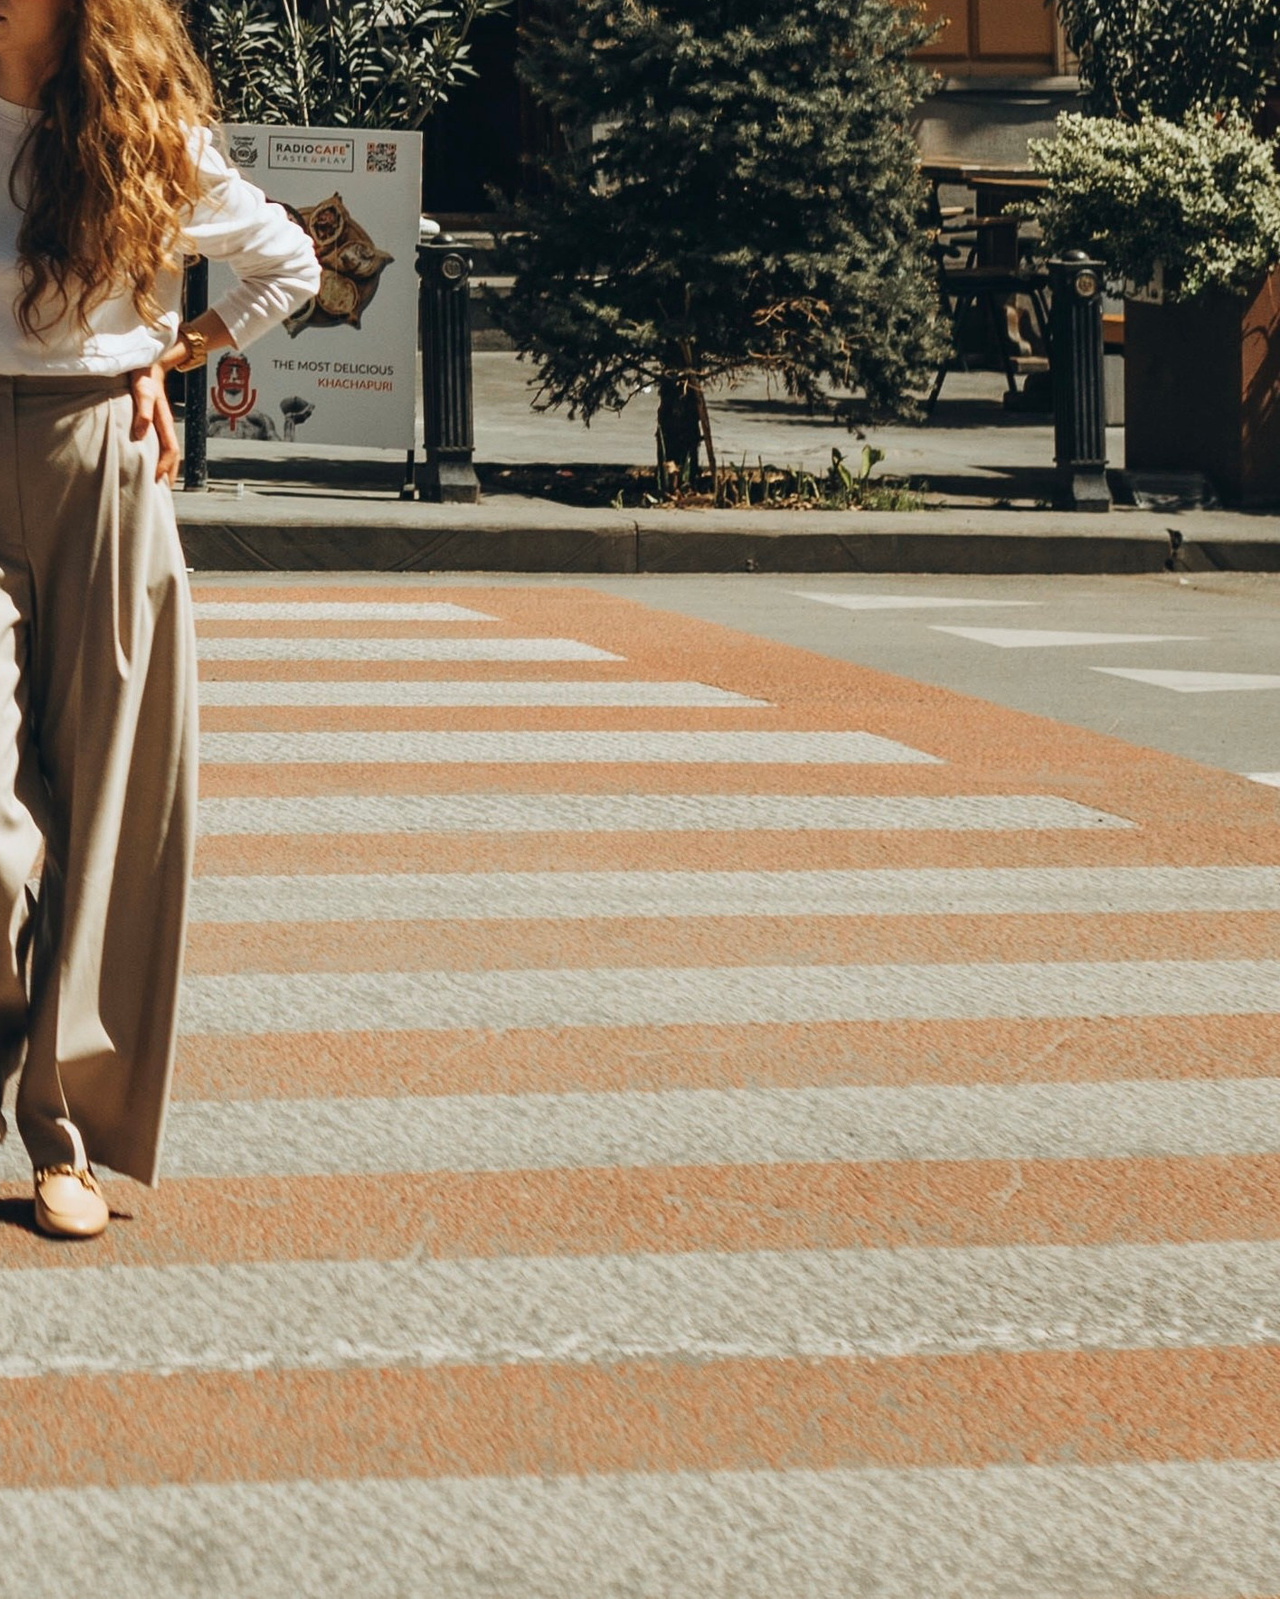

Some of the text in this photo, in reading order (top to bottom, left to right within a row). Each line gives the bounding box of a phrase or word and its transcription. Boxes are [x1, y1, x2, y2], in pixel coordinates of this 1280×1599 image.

[272, 359, 395, 376] THE MOST DELICIOUS
[317, 378, 394, 392] KHACHAPURI
